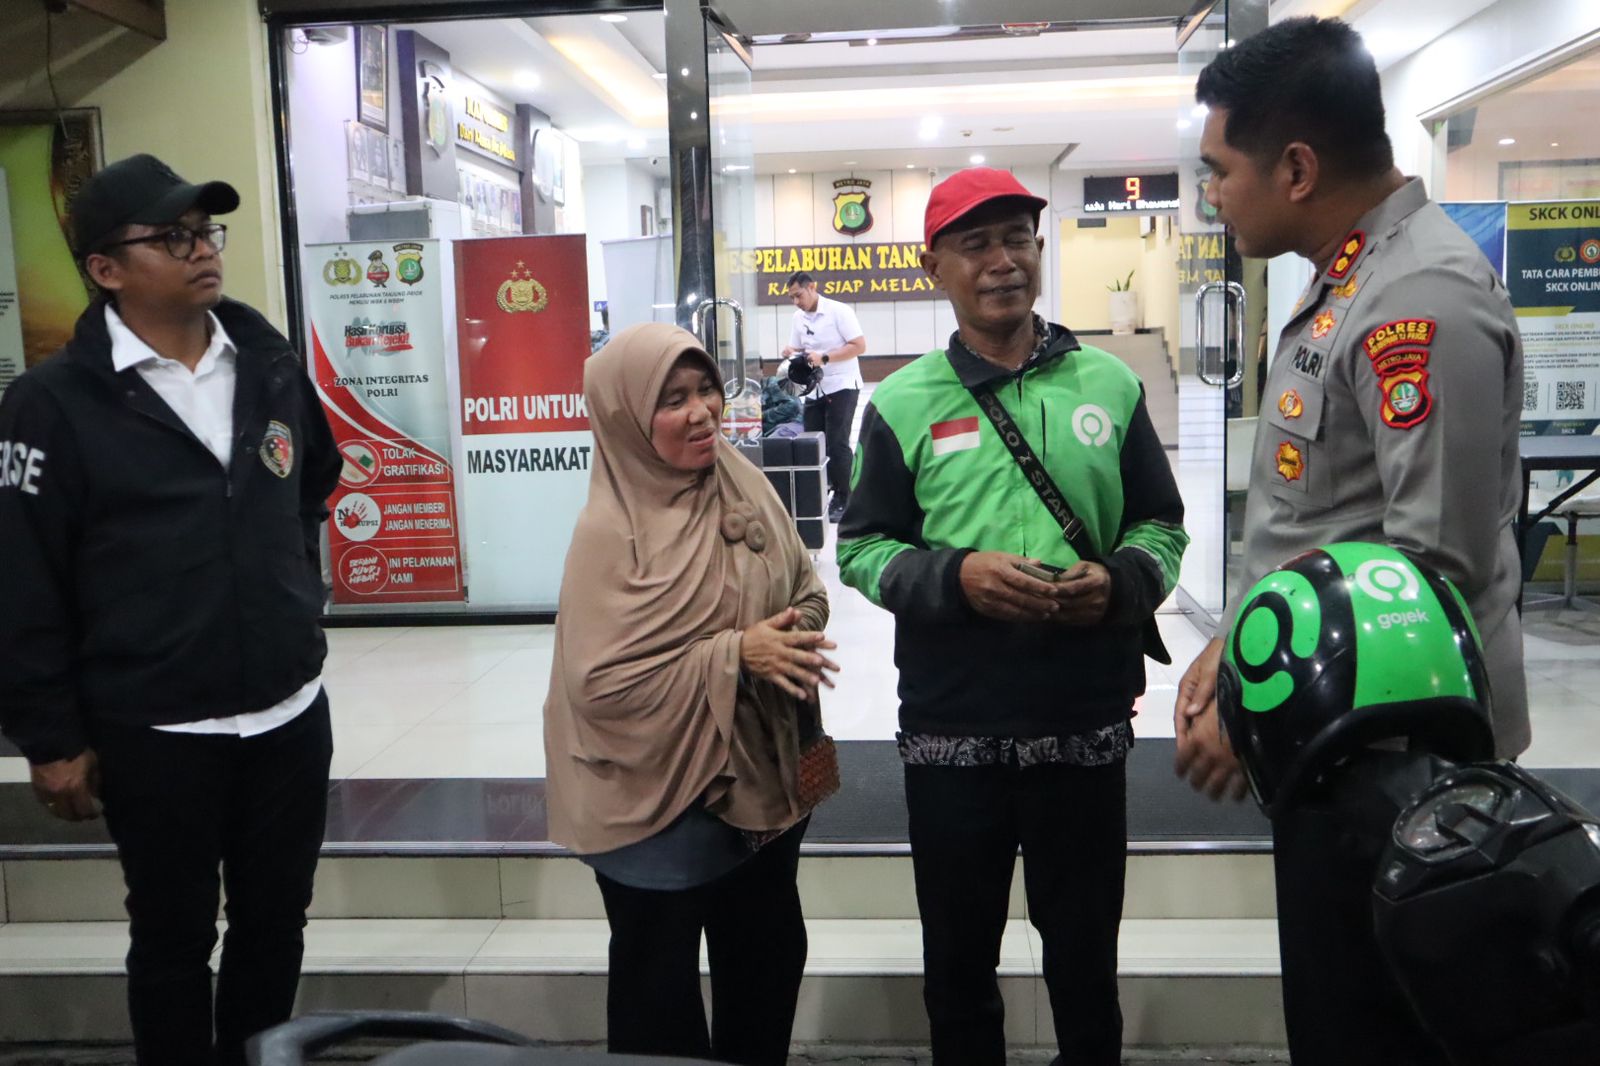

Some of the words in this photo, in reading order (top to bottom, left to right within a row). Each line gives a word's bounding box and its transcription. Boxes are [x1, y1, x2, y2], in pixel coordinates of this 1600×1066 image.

[1126, 177, 1140, 200] 9
[1529, 207, 1568, 220] SKCK
[755, 246, 872, 273] PELABUHAN
[1521, 269, 1543, 279] TATA
[1545, 269, 1570, 279] CARA
[1572, 268, 1600, 278] PEMB
[823, 279, 864, 295] SIAP
[1546, 282, 1569, 292] SKCK
[1368, 322, 1428, 349] POLRES
[335, 377, 363, 386] ZONA
[366, 374, 429, 385] INTEGRITAS
[367, 389, 398, 398] POLRI
[464, 396, 519, 422] POLRI
[523, 393, 589, 420] UNTUK
[981, 393, 1020, 447] POLO
[382, 448, 415, 459] TOLAK
[467, 446, 591, 474] MASYARAKAT
[383, 463, 444, 476] GRATIFIKASI
[384, 503, 414, 515] JANGAN
[414, 502, 445, 514] MEMBERI
[385, 519, 414, 531] JANGAN
[415, 518, 450, 530] MENERIMA
[389, 558, 400, 568] INI
[402, 556, 455, 568] PELAYANAN
[390, 572, 413, 584] KAMI
[1377, 607, 1430, 629] gojek
